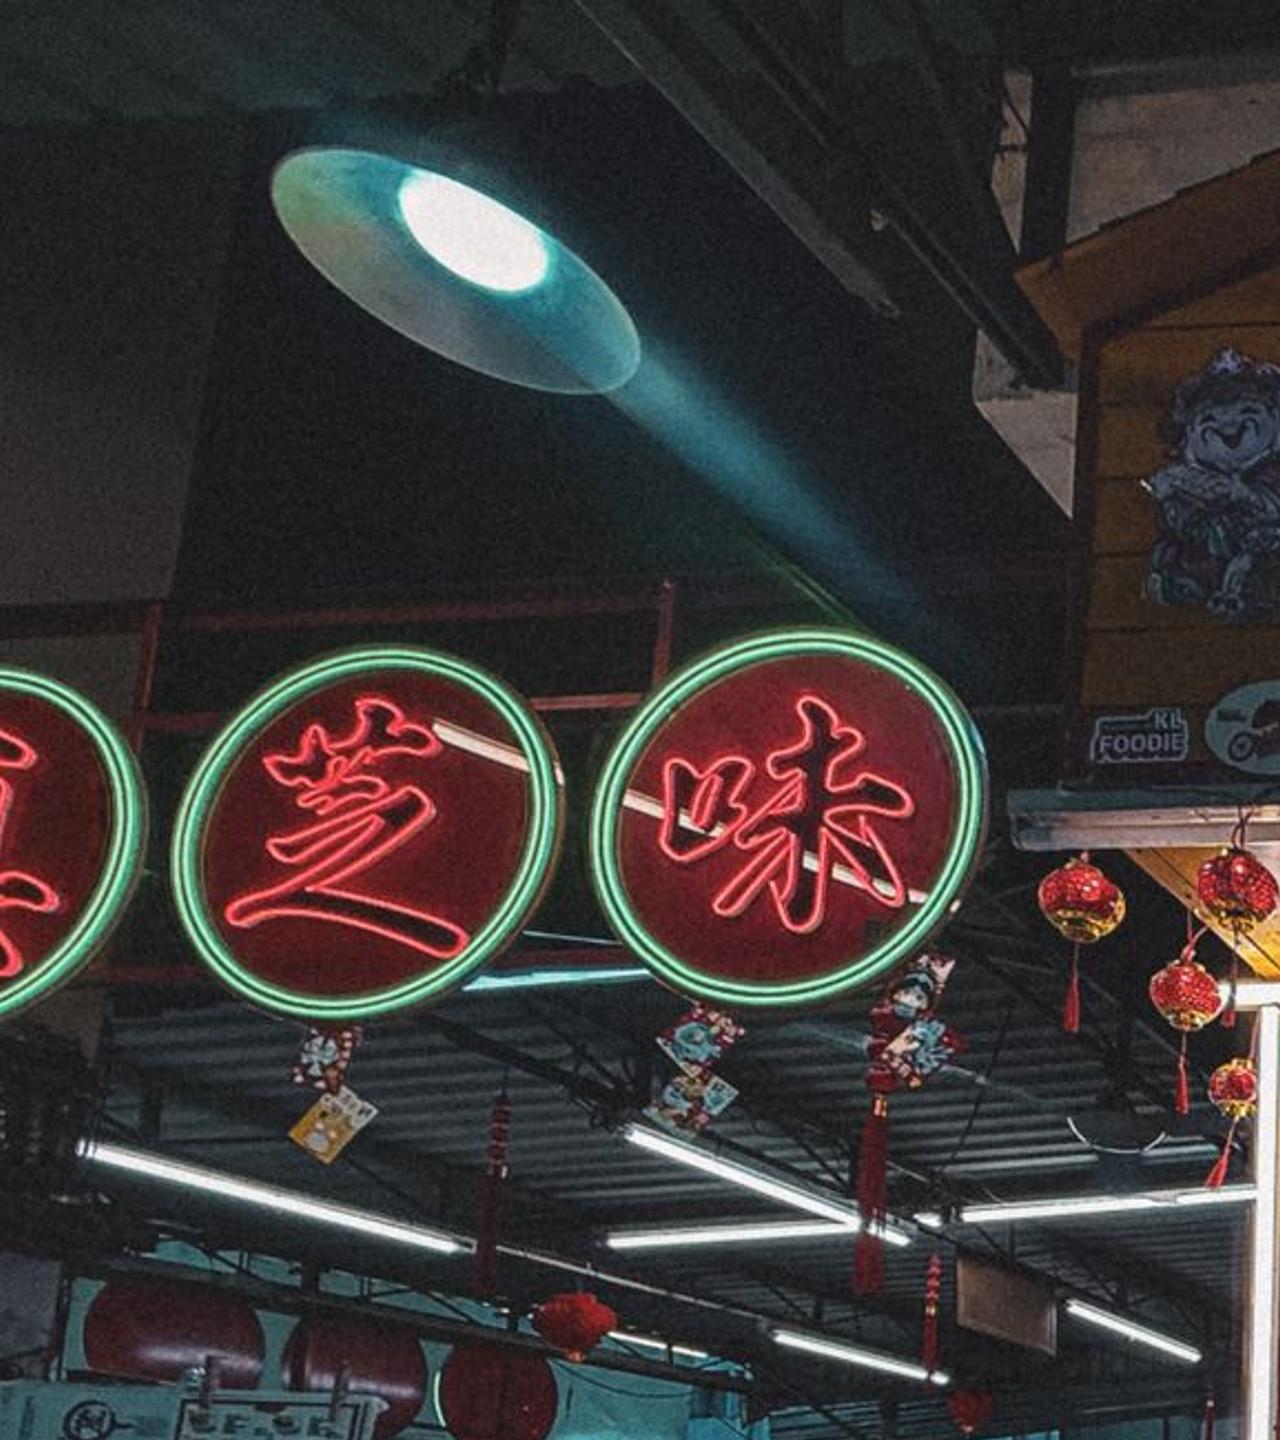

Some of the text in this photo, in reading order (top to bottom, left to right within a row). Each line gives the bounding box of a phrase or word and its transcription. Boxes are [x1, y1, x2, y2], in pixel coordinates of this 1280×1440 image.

[1098, 735, 1186, 754] FOODIE
[1154, 711, 1182, 730] KL
[223, 695, 472, 964] 芝
[657, 693, 917, 937] 味
